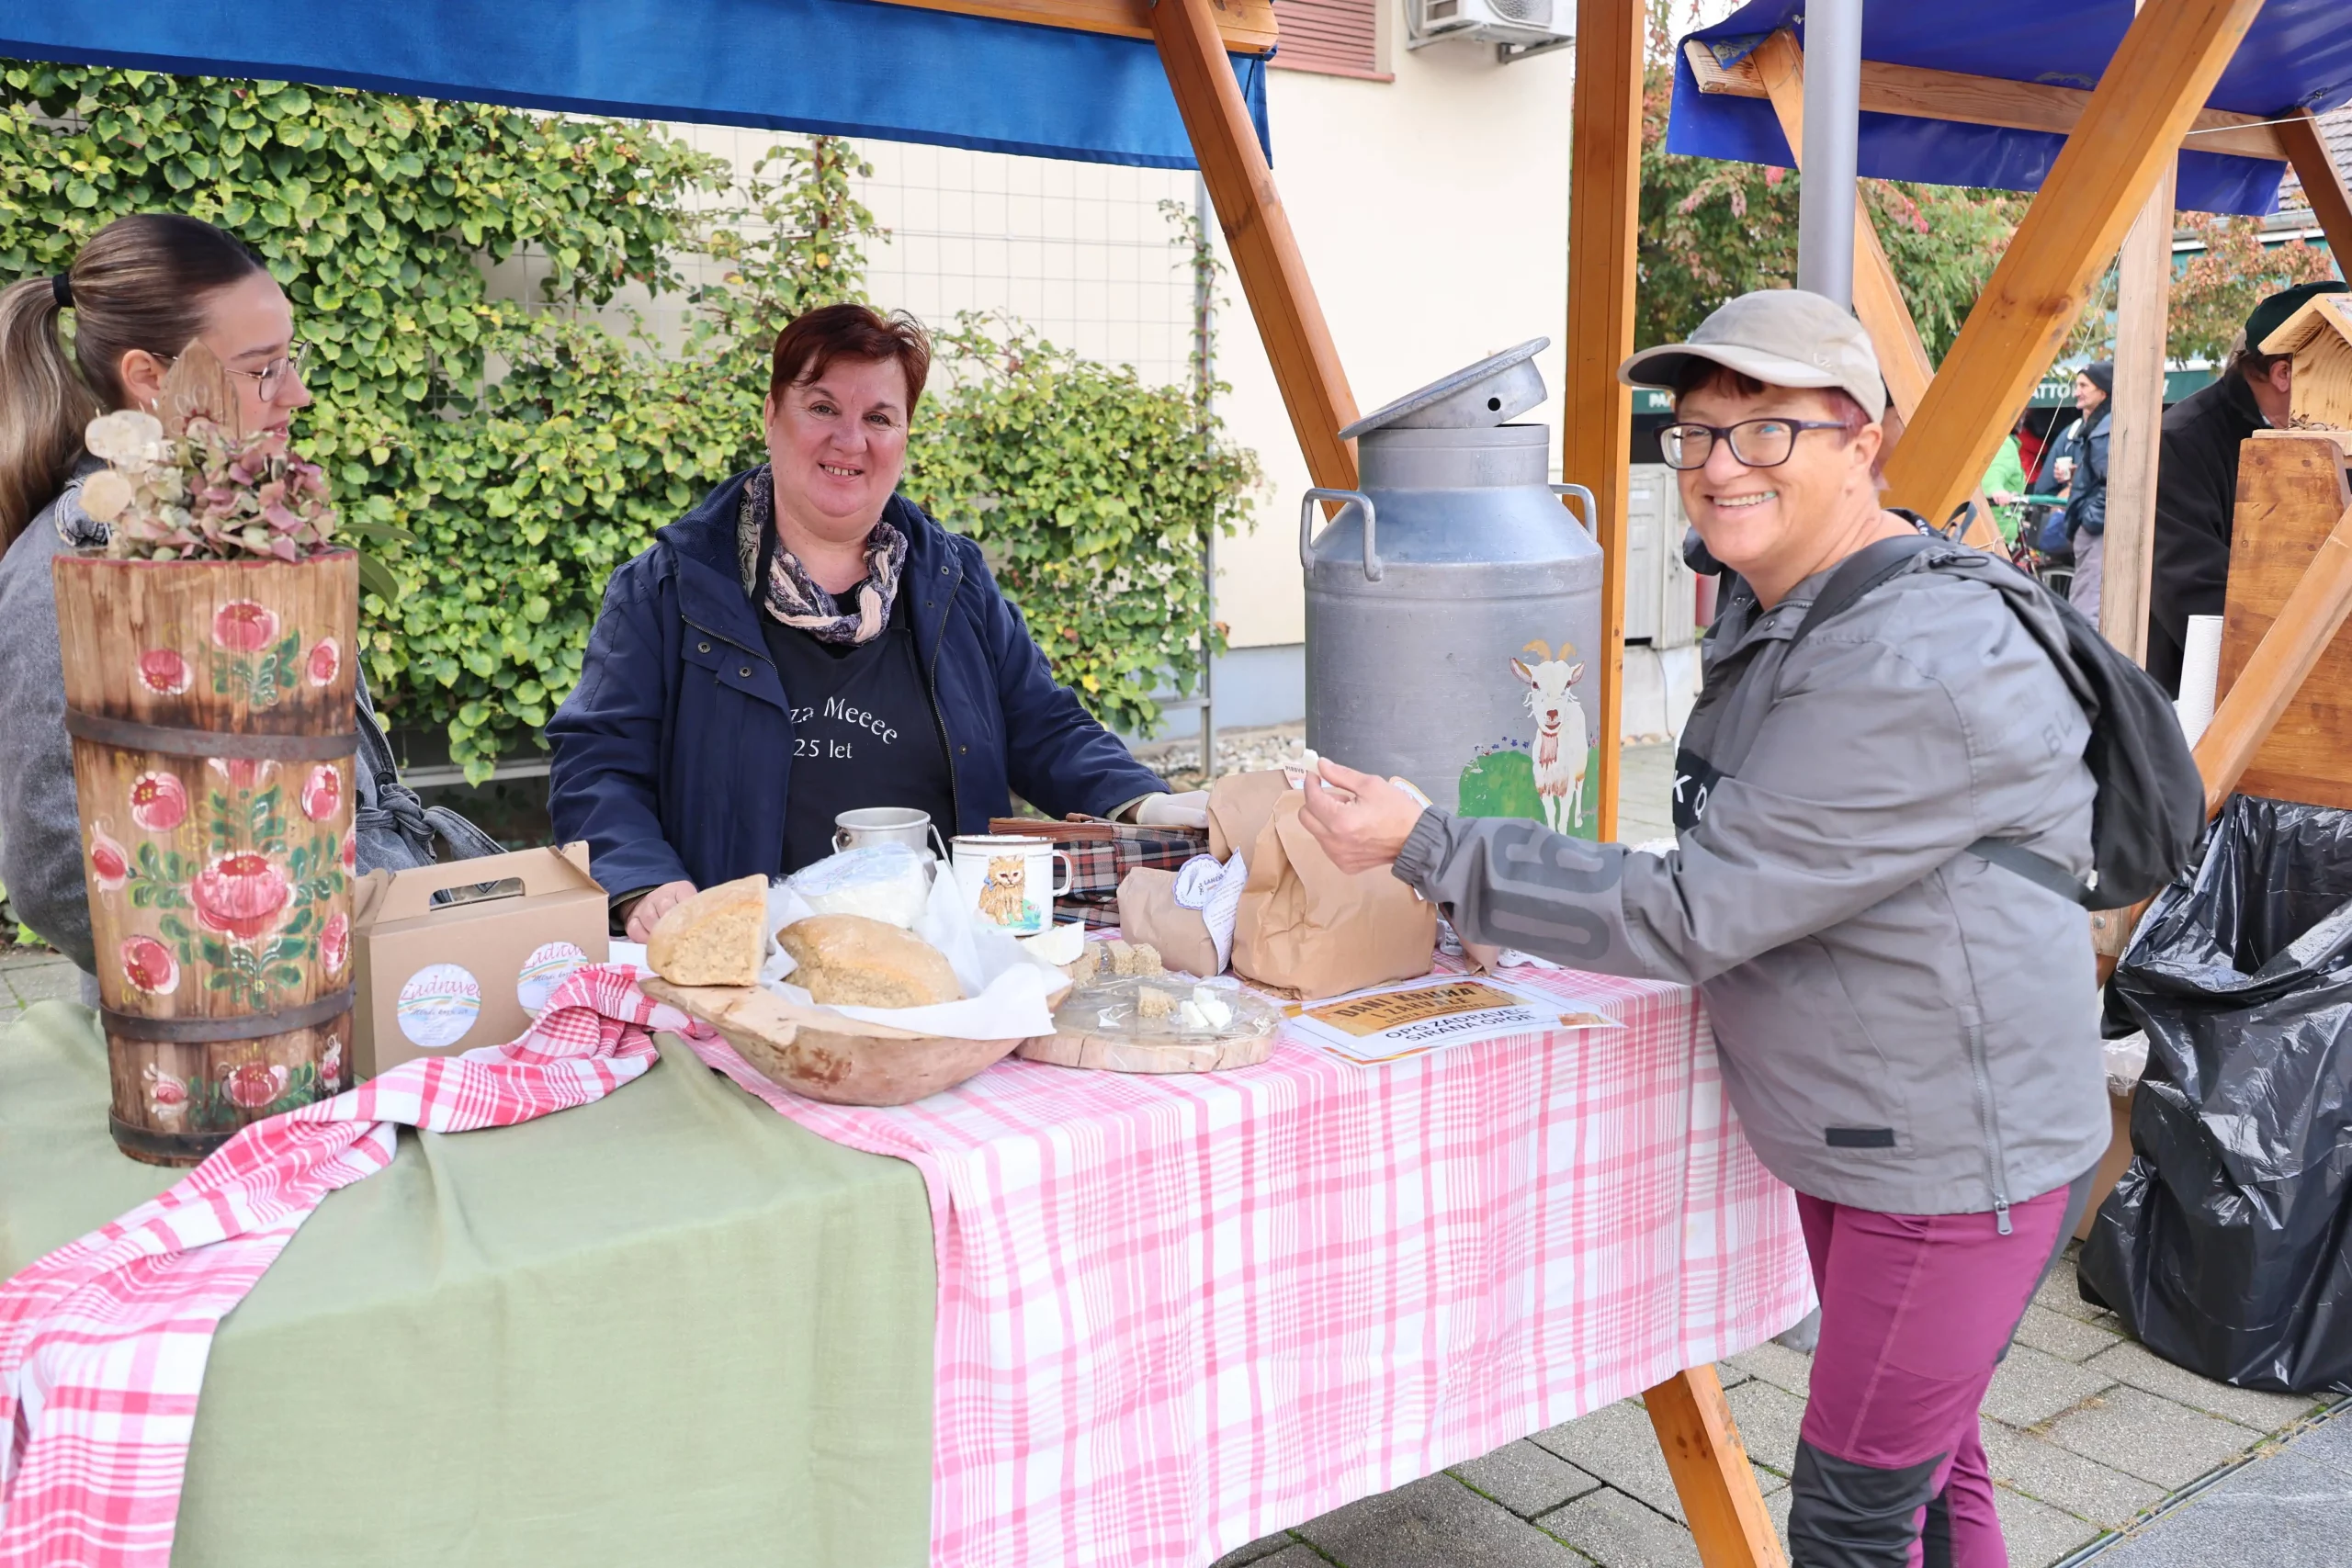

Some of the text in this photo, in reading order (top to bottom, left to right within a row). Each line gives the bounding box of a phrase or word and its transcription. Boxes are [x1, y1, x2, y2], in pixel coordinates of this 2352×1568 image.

[823, 696, 898, 745] Meeee
[793, 739, 853, 759] 25 let
[1334, 987, 1477, 1018] DANI KRUHA
[1383, 997, 1470, 1015] ZAHVALE
[1385, 1008, 1531, 1039] OPG ZADRAVEC
[1406, 1013, 1538, 1042] SIRANA OPOR
